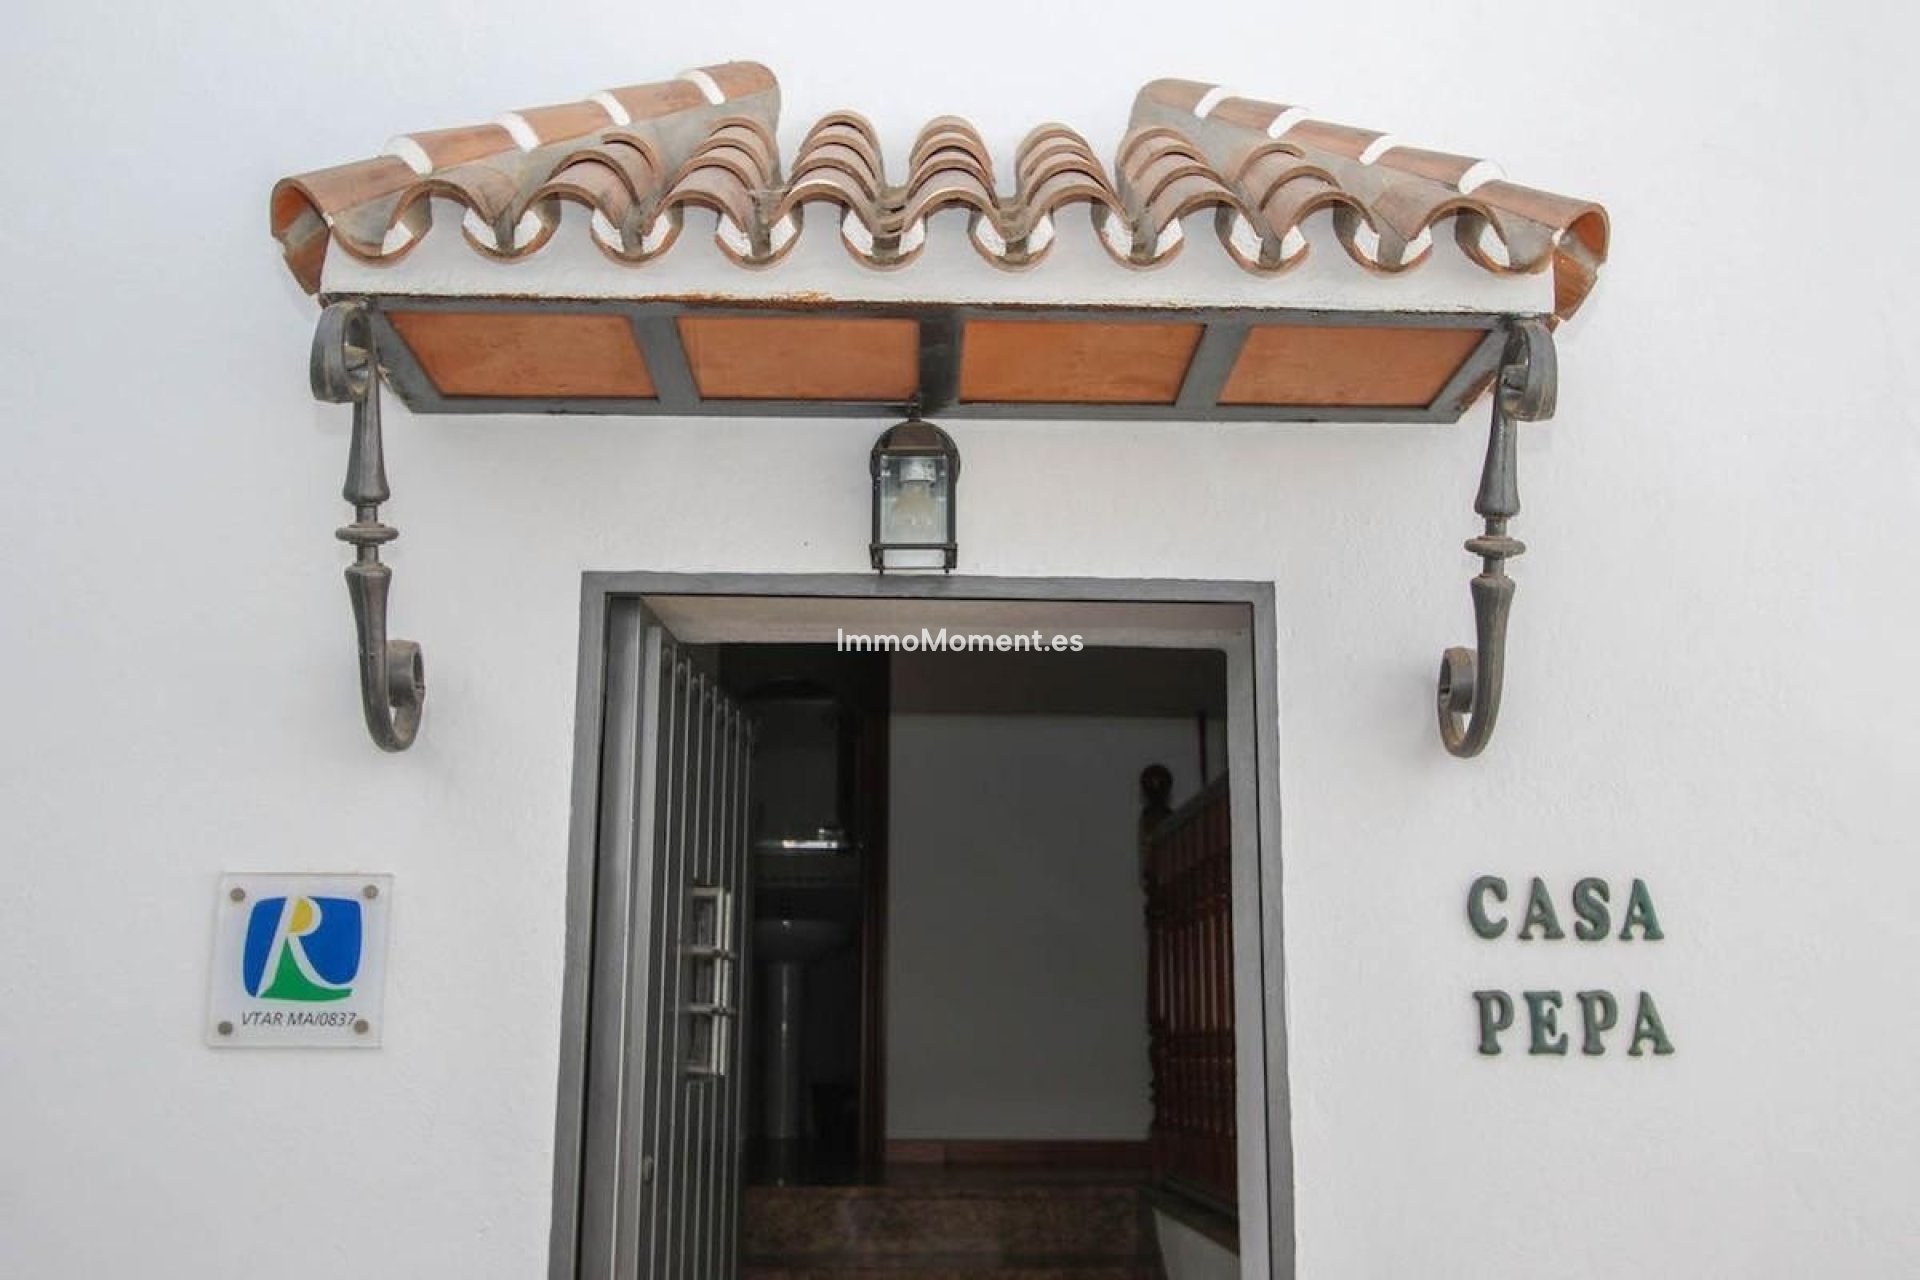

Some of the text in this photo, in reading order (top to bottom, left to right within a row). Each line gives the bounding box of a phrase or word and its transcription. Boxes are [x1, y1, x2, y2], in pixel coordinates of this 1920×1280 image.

[1467, 874, 1665, 941] CASA
[241, 1012, 284, 1027] VTAR
[1472, 989, 1676, 1056] PEPA
